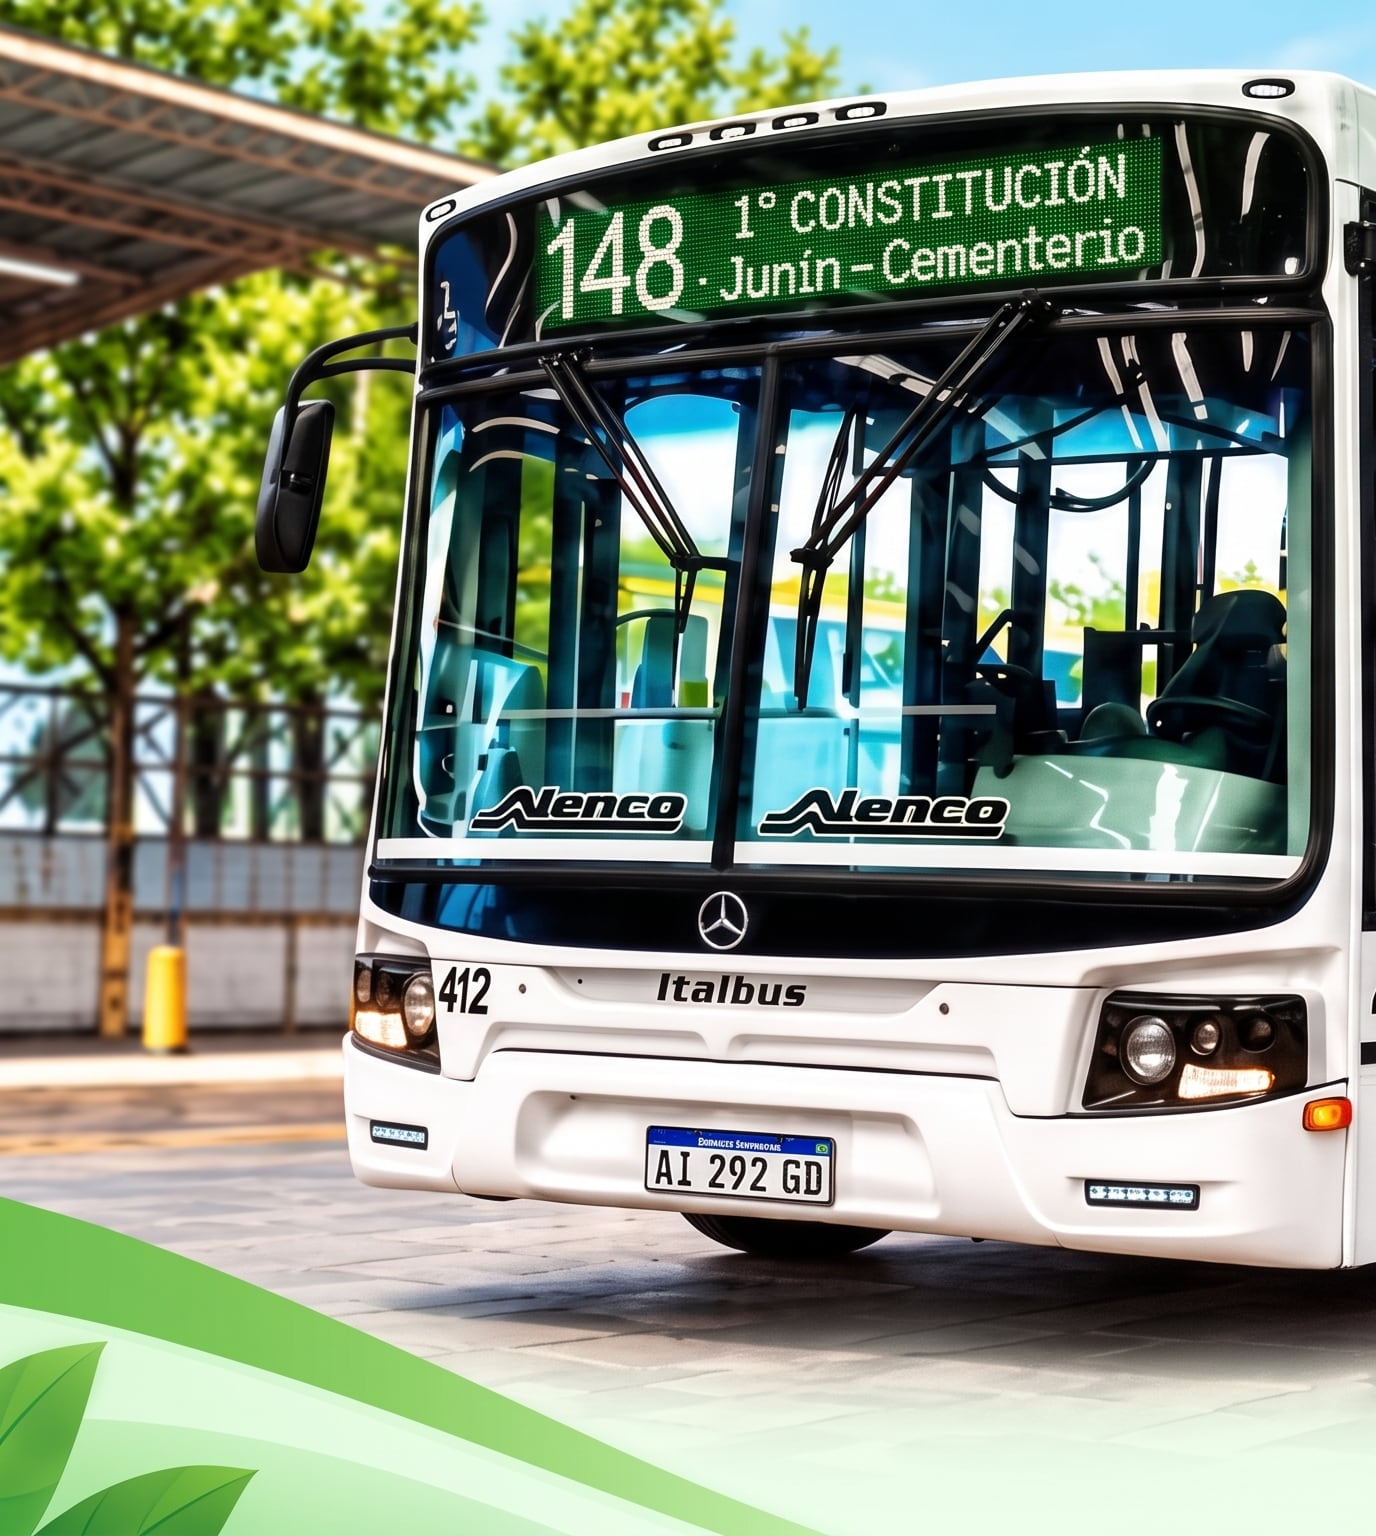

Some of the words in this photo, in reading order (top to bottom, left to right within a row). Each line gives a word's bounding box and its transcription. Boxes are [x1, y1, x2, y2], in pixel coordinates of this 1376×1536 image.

[790, 146, 1126, 234] CONSTITUCIÓN
[547, 204, 684, 319] 148
[719, 249, 841, 301] Junín
[883, 217, 1146, 284] Cementerio
[438, 966, 491, 1015] 412
[657, 972, 807, 1007] Italbus
[655, 1149, 692, 1187] AI
[708, 1154, 768, 1192] 292
[782, 1159, 822, 1195] GD
